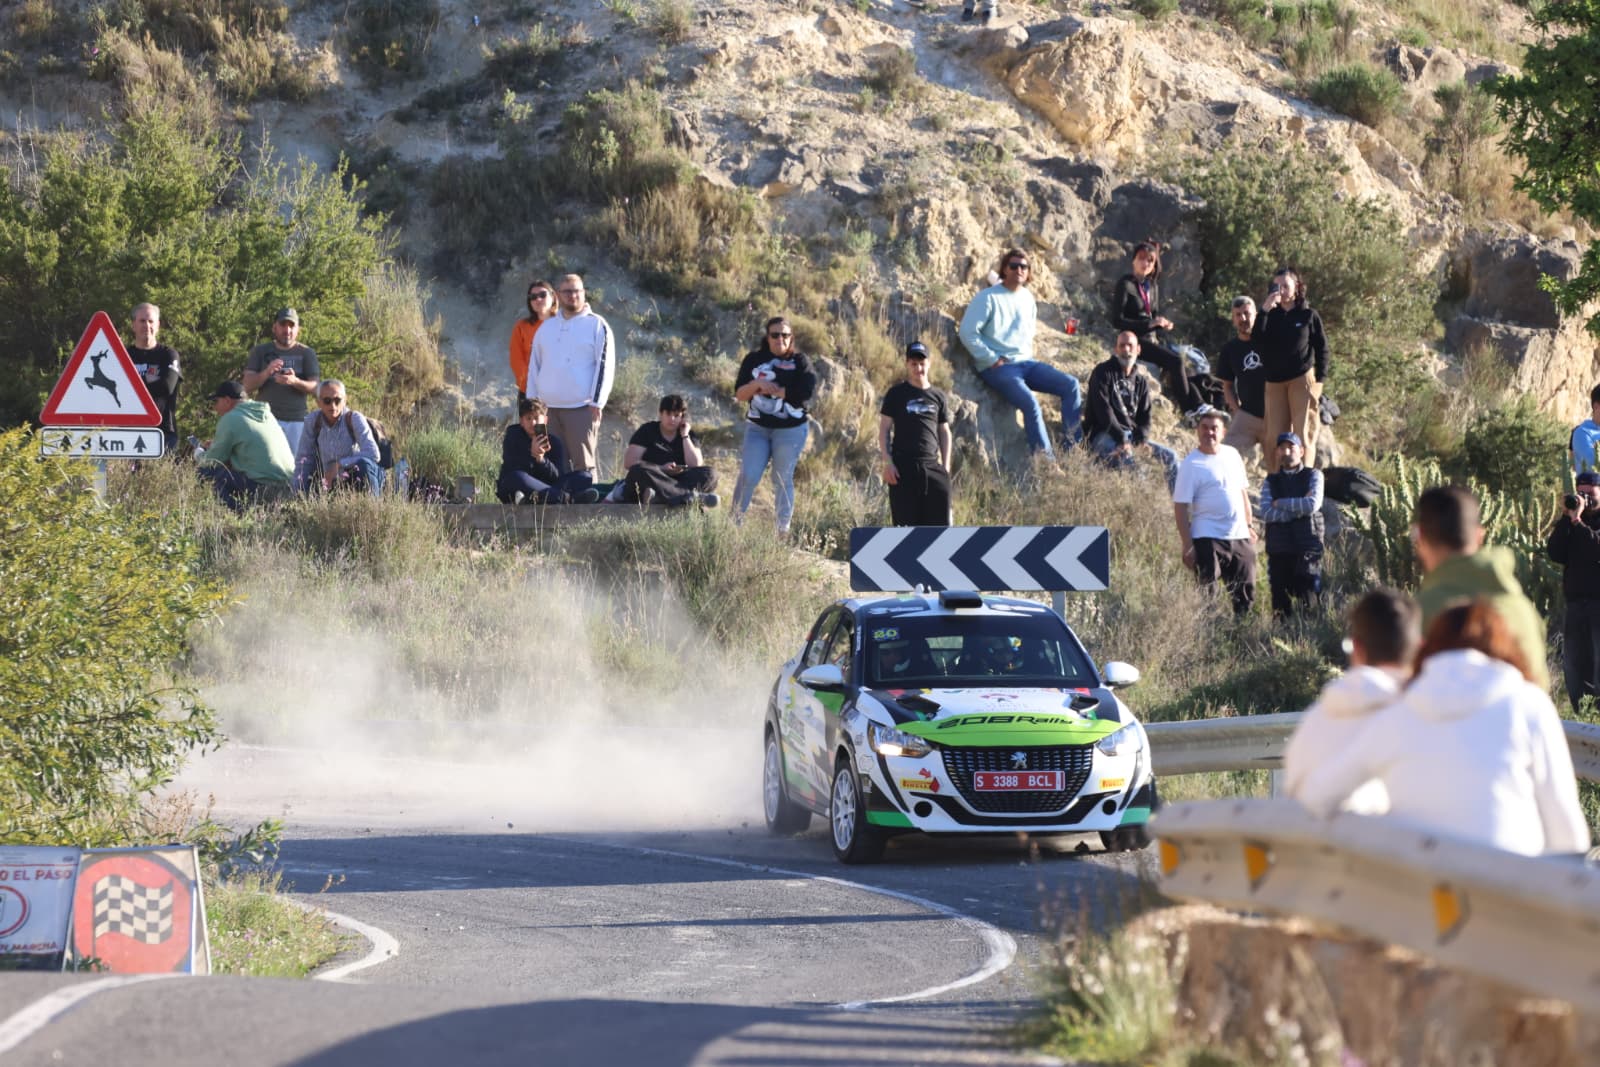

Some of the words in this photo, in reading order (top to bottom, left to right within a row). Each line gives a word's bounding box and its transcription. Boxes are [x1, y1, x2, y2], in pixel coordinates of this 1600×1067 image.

[80, 436, 92, 451] 3
[99, 436, 125, 451] km
[976, 775, 984, 787] S
[993, 775, 1019, 787] 3388
[1028, 775, 1053, 787] BCL
[13, 870, 30, 880] EL
[35, 870, 73, 880] PASO
